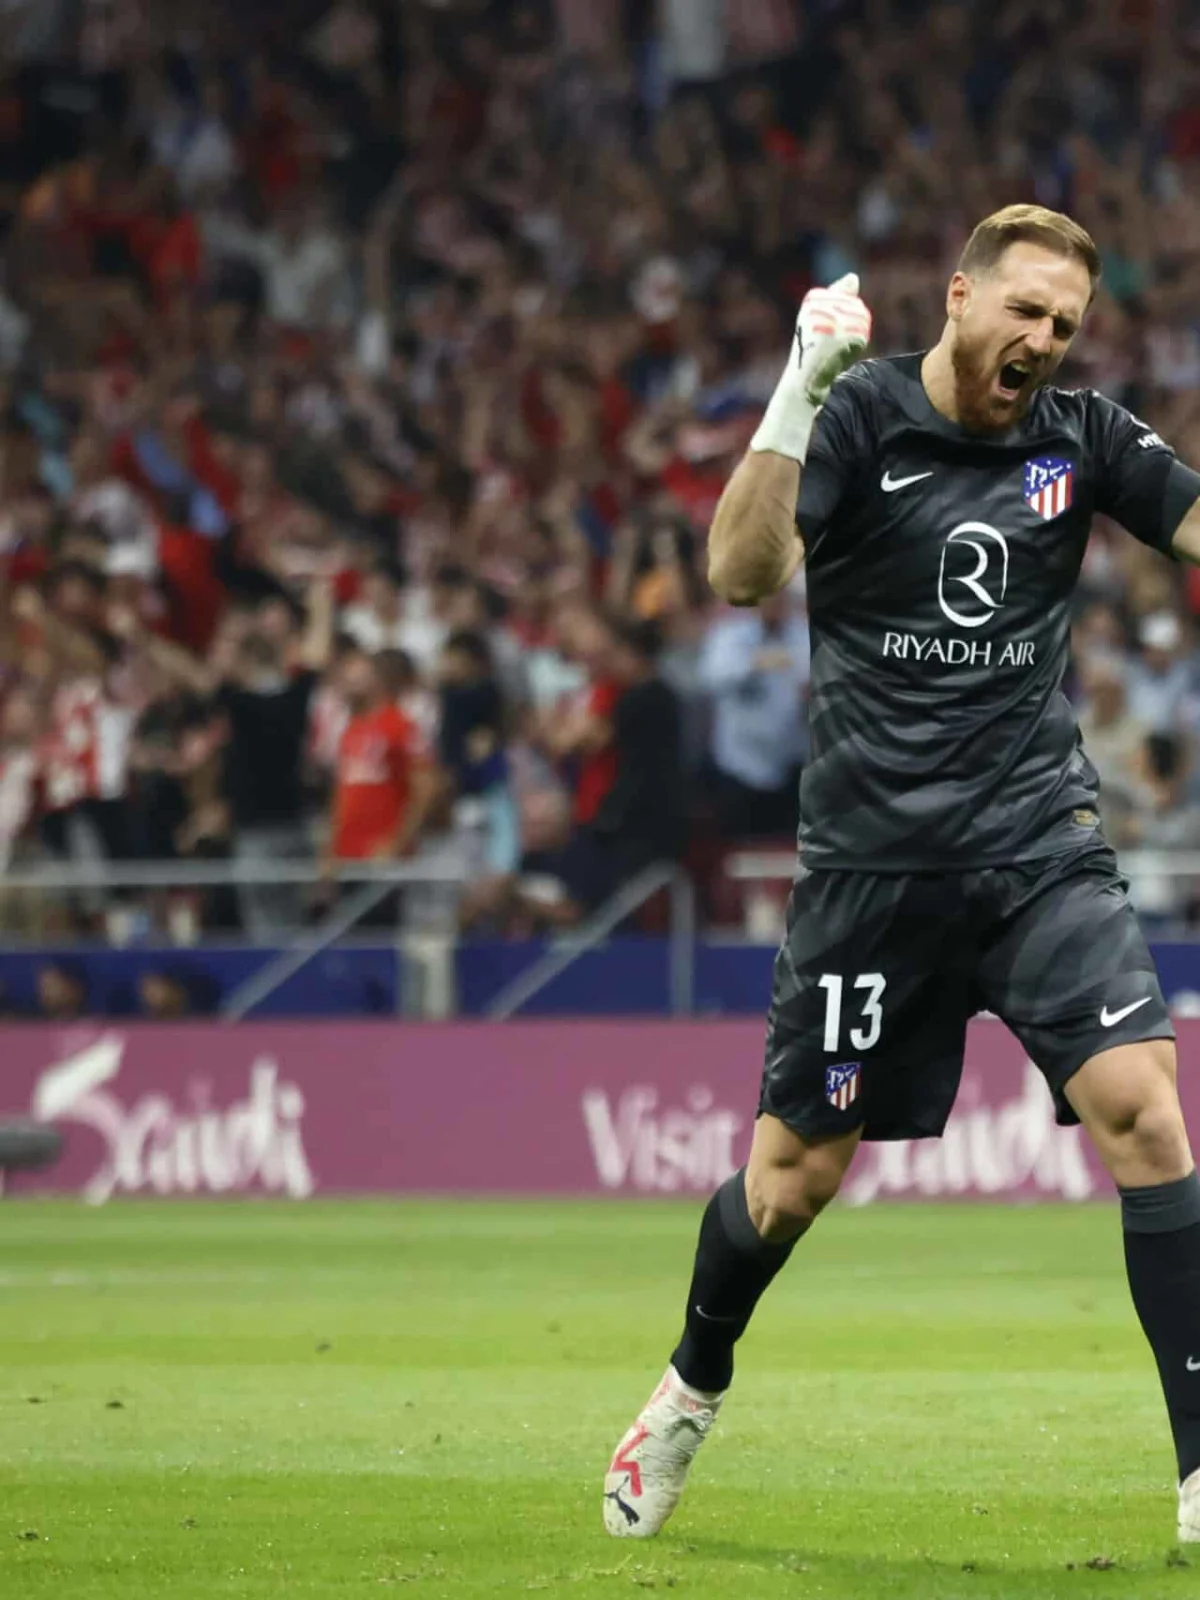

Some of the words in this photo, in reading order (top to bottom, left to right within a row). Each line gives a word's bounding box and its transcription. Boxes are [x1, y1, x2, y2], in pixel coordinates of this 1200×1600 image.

[882, 632, 992, 666] RIYADH
[998, 641, 1035, 667] AIR
[818, 973, 886, 1053] 13
[584, 1084, 742, 1190] Visit
